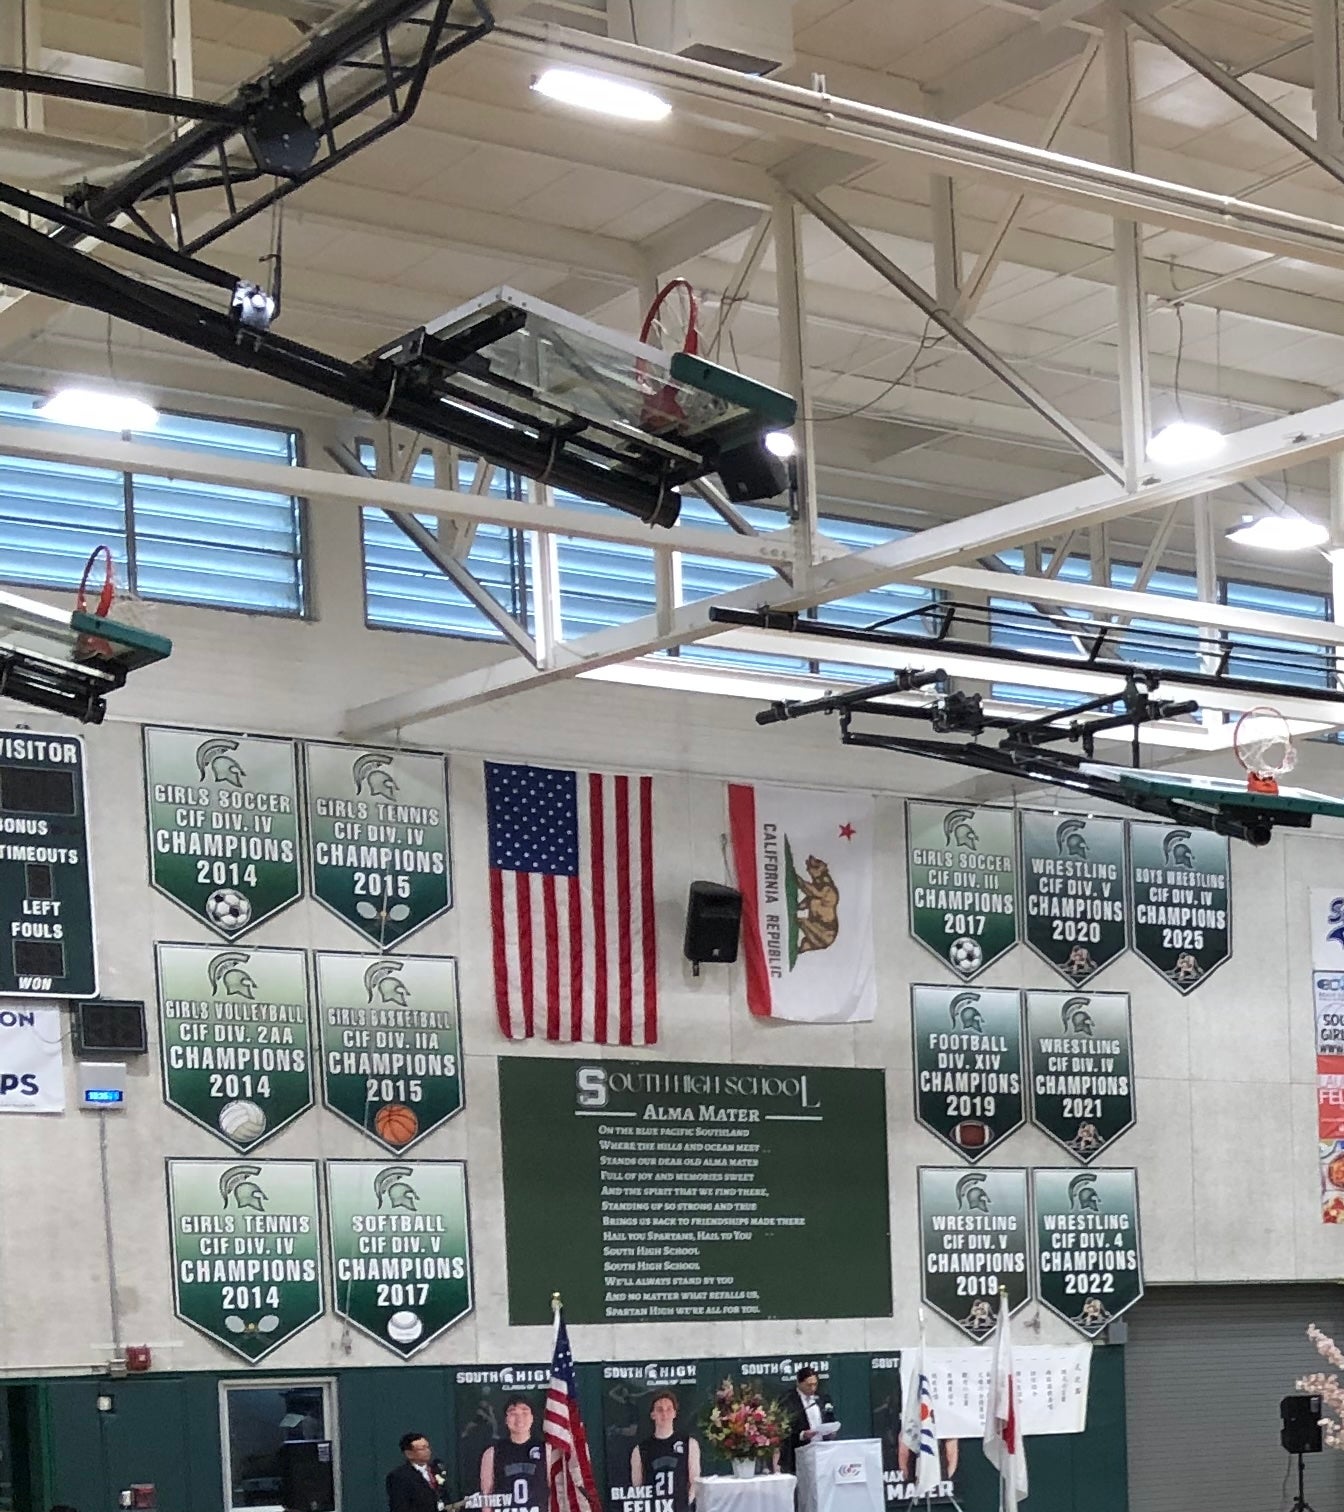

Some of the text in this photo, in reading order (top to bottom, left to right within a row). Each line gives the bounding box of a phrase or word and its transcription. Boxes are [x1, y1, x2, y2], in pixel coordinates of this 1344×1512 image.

[154, 784, 291, 814] GIRLS SOCCER
[176, 808, 272, 833] CIF DIV. IV
[316, 798, 440, 826] GIRLS TENNIS
[334, 821, 424, 846] CIF DIV. IV
[156, 830, 293, 863] CHAMPIONS
[316, 842, 444, 874] CHAMPIONS
[913, 850, 1012, 873] GIRLS SOCCER
[197, 860, 257, 887] 2014
[928, 869, 950, 886] CIF
[954, 872, 982, 889] DIV.
[1031, 859, 1117, 881] WRESTLING
[354, 872, 411, 898] 2015
[1039, 876, 1111, 897] CIF DIV. V
[763, 823, 782, 979] CALIFORNIA REPUBLIC
[914, 889, 1013, 915] CHAMPIONS
[1149, 887, 1212, 906] CIF DIV. IV
[23, 900, 61, 916] LEFT
[1028, 895, 1123, 922] CHAMPIONS
[1137, 907, 1226, 930] CHAMPIONS
[11, 922, 63, 939] FOULS
[944, 914, 986, 935] 2017
[1052, 921, 1101, 943] 2020
[1162, 929, 1203, 950] 2025
[19, 977, 52, 991] WON
[165, 1000, 304, 1024] GIRLS VOLLEYBALL
[327, 1008, 450, 1030] GIRLS BASKETBALL
[179, 1023, 293, 1044] CIF DIV. 2AA
[343, 1030, 439, 1050] CIF DIV. IIA
[930, 1033, 1008, 1051] FOOTBALL
[1039, 1038, 1120, 1055] WRESTLING
[170, 1045, 305, 1072] CHAMPIONS
[328, 1051, 456, 1076] CHAMPIONS
[938, 1053, 1000, 1071] DIV. XIV
[1048, 1057, 1114, 1073] CIF DIV. IV
[209, 1074, 271, 1098] 2014
[366, 1079, 423, 1102] 2015
[920, 1071, 1020, 1095] CHAMPIONS
[1035, 1074, 1128, 1096] CHAMPIONS
[643, 1104, 760, 1122] ALMA MATER
[946, 1096, 995, 1118] 2019
[1062, 1098, 1102, 1118] 2021
[180, 1215, 310, 1234] GIRLS TENNIS
[352, 1215, 446, 1233] SOFTBALL
[932, 1215, 1017, 1231] WRESTLING
[1043, 1214, 1130, 1230] WRESTLING
[200, 1236, 295, 1255] CIF DIV. IV
[359, 1236, 440, 1254] CIF DIV. V
[943, 1234, 1008, 1250] CIF DIV. V
[1052, 1232, 1123, 1248] CIF DIV. 4
[180, 1259, 316, 1283] CHAMPIONS
[338, 1257, 465, 1280] CHAMPIONS
[927, 1252, 1024, 1273] CHAMPIONS
[1041, 1250, 1137, 1272] CHAMPIONS
[956, 1275, 998, 1296] 2019
[1065, 1273, 1114, 1294] 2022
[221, 1286, 280, 1310] 2014
[376, 1284, 429, 1306] 2017
[456, 1371, 497, 1384] SOUTH
[604, 1365, 696, 1379] SOUTH HIGH
[742, 1363, 778, 1375] SOUTH
[513, 1479, 528, 1504] 0
[611, 1485, 653, 1500] BLAKE
[655, 1472, 673, 1496] 21
